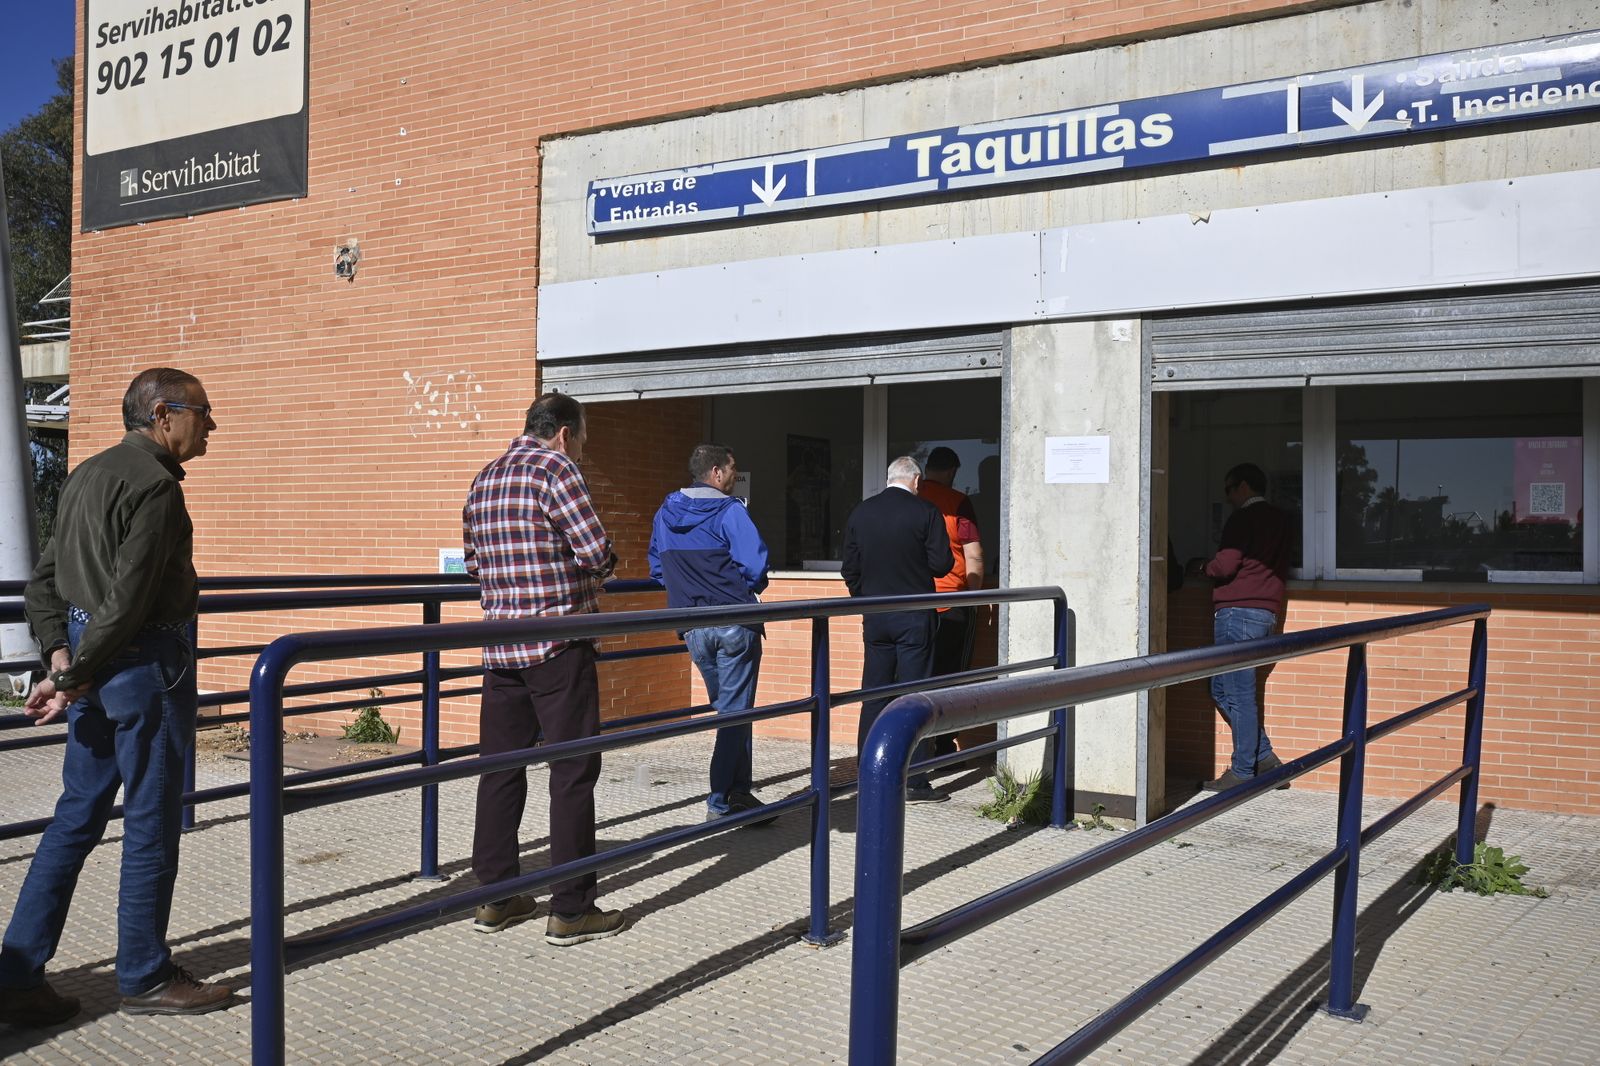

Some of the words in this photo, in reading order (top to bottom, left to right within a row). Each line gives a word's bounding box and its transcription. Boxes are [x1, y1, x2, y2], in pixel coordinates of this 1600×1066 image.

[96, 0, 274, 48] Servihabitat.c
[96, 51, 148, 95] 902
[160, 39, 195, 79] 15
[203, 26, 240, 69] 01
[252, 13, 293, 57] 02
[1415, 54, 1523, 86] Salida
[906, 112, 1174, 178] Taquillas
[142, 149, 261, 194] Servihabitat
[610, 178, 665, 199] Venta
[672, 174, 697, 190] de
[610, 200, 699, 224] Entradas
